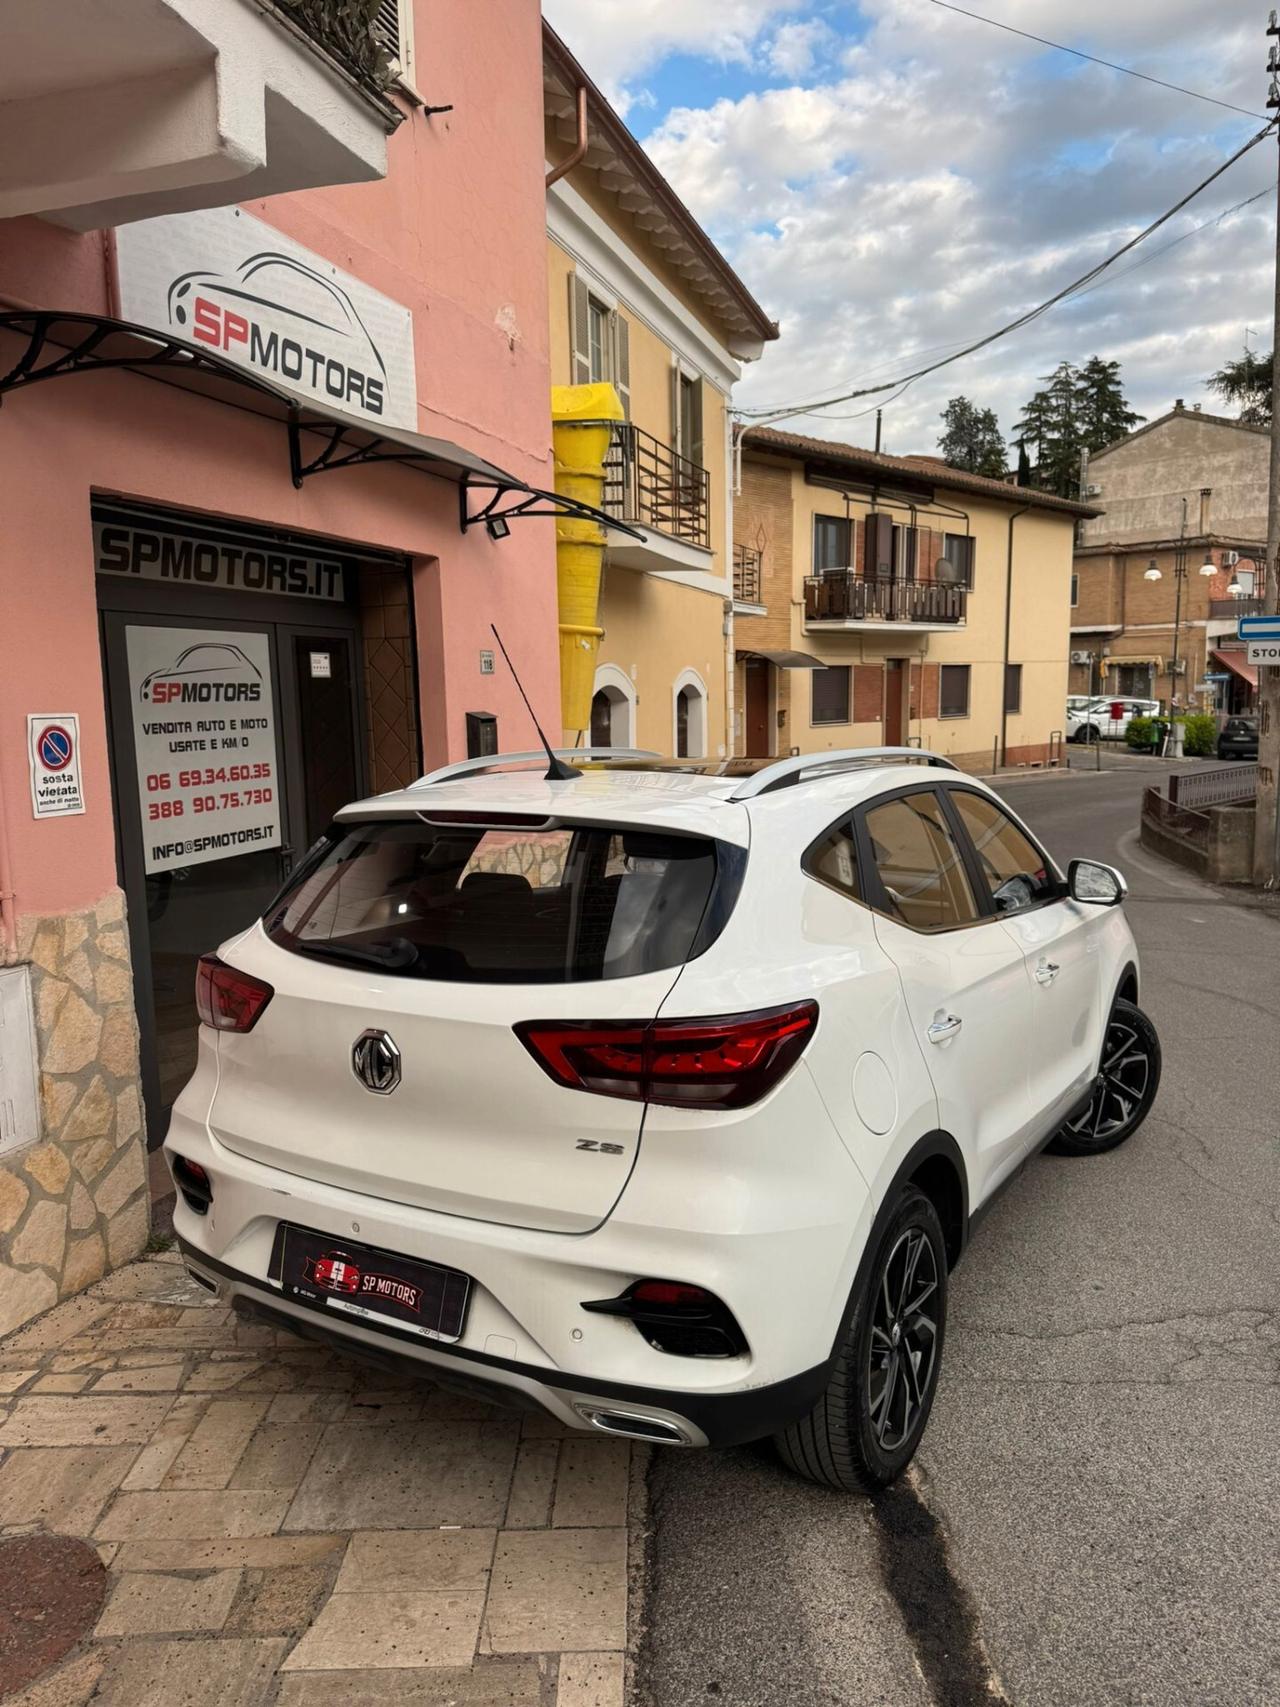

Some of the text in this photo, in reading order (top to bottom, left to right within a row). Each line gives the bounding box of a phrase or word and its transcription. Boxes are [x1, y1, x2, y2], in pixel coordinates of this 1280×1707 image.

[193, 296, 384, 416] SPMOTORS
[99, 527, 341, 598] SPMOTORS.IT
[1252, 648, 1280, 658] STO
[152, 682, 261, 704] SPMOTORS
[142, 718, 268, 735] VENDITA AUTO E MOTO
[169, 740, 206, 753] USATE
[210, 739, 218, 750] E
[42, 773, 74, 784] sosta
[146, 763, 271, 792] 06 69.34.60.35
[38, 785, 78, 798] vietata
[148, 788, 272, 820] 388 90.75.730
[152, 825, 275, 861] INFO@SPMOTORS.IT
[353, 1037, 394, 1089] MG
[575, 1138, 625, 1155] ZS
[362, 1275, 417, 1306] SP MOTORS
